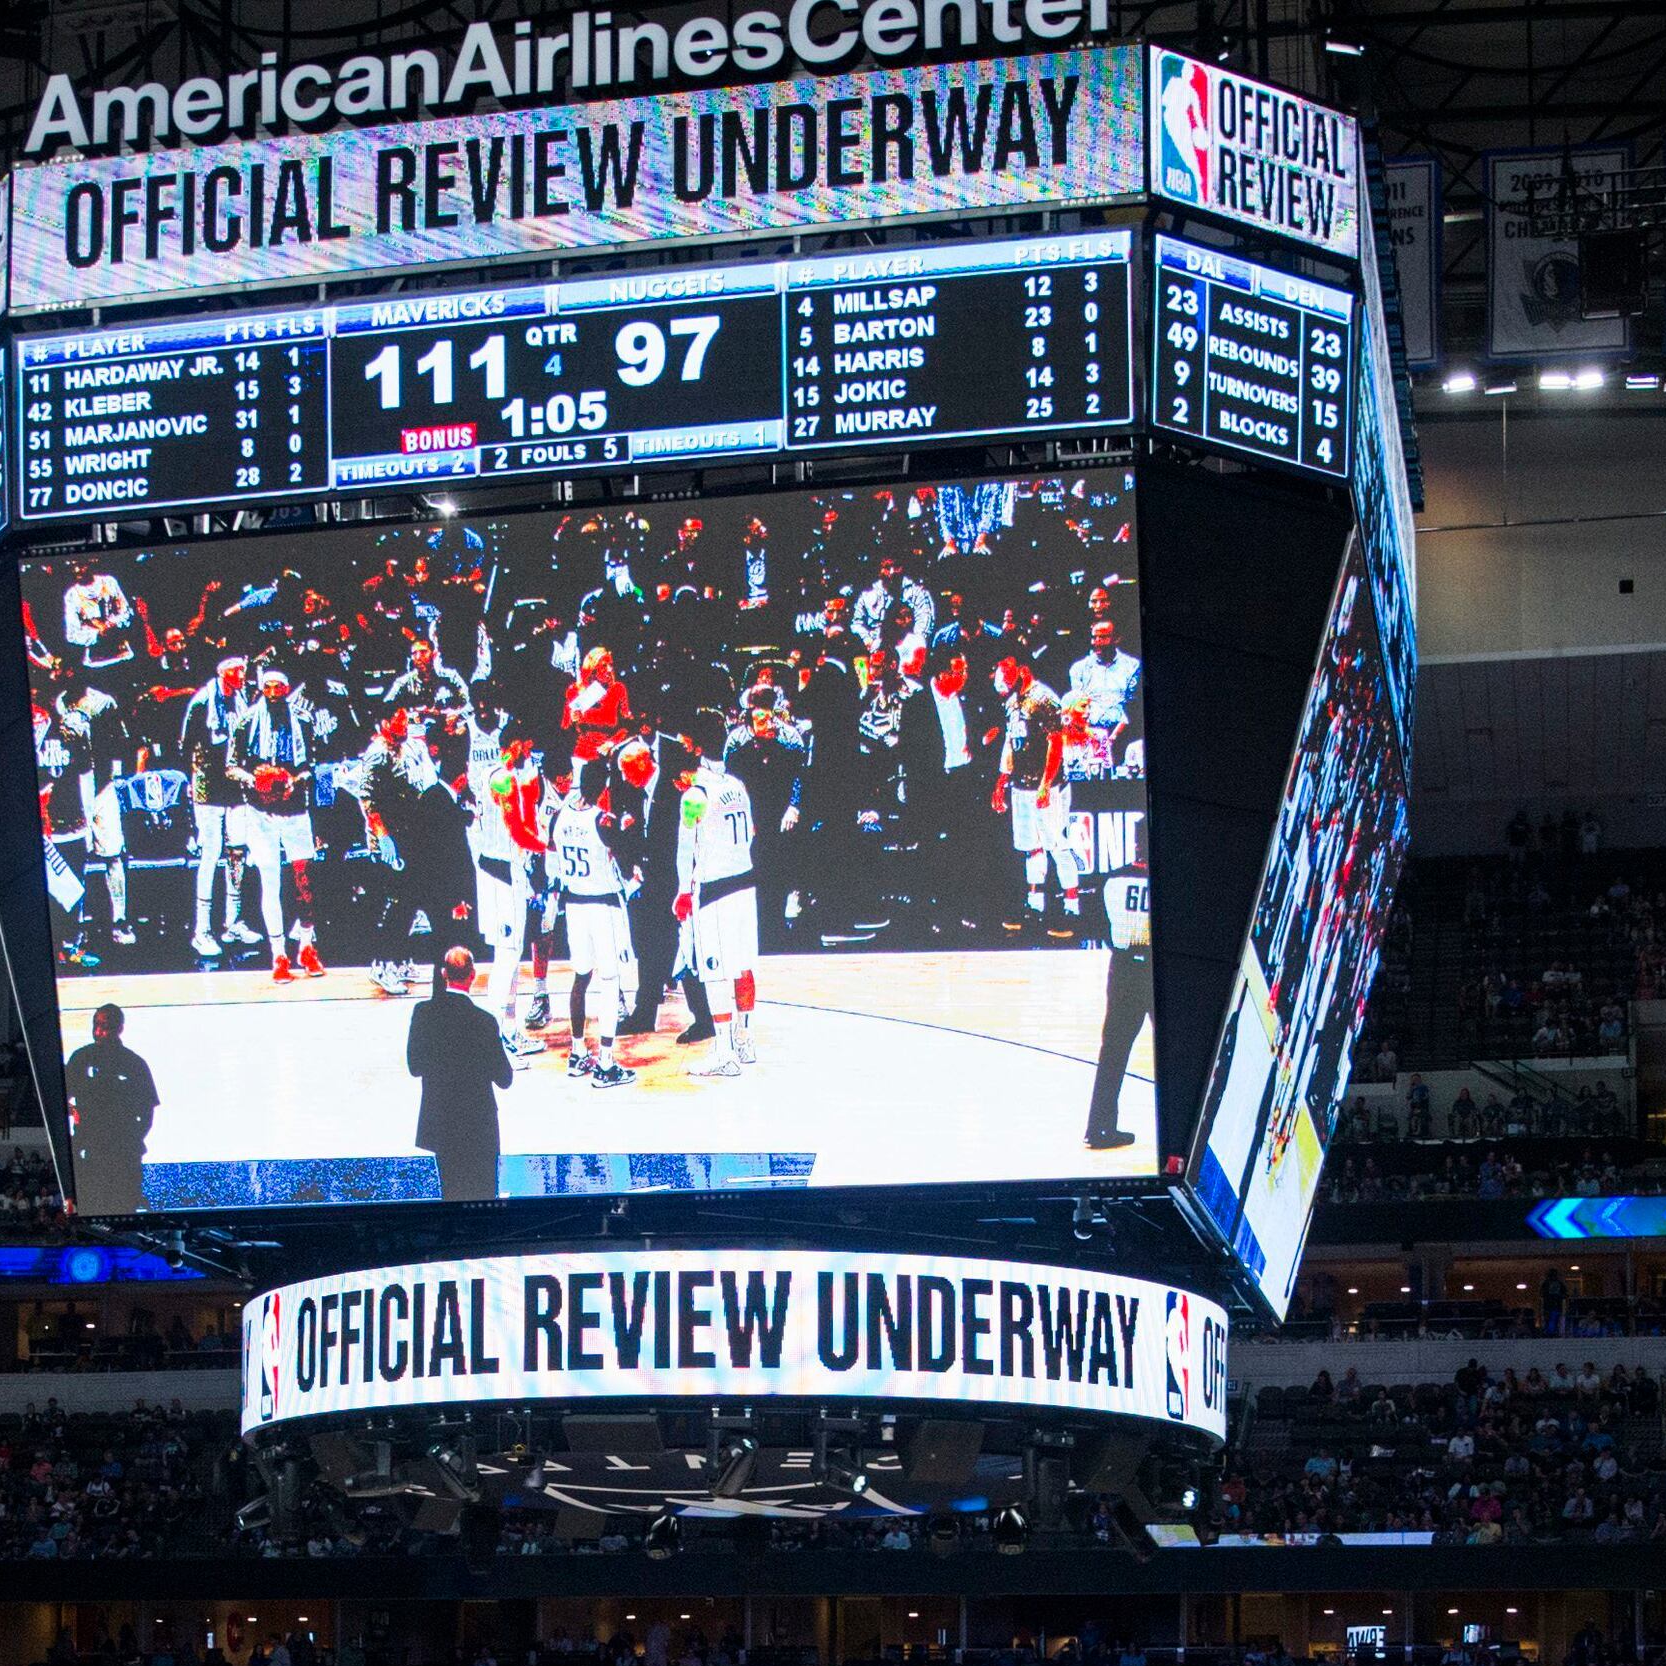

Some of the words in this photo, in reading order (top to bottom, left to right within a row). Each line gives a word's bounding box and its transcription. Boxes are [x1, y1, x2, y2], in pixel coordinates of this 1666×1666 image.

[1219, 78, 1346, 178] OFFICIAL
[65, 155, 351, 269] OFFICIAL
[376, 119, 645, 235] REVIEW
[672, 76, 1081, 203] UNDERWAY
[1218, 144, 1335, 240] REVIEW
[834, 255, 924, 282] PLAYER
[1014, 244, 1061, 265] PTS
[1069, 239, 1113, 261] FLS
[1187, 249, 1226, 283] DAL
[1284, 279, 1325, 312] DEN
[371, 293, 506, 327] MAVERICKS
[609, 272, 726, 303] NUGGETS
[797, 296, 814, 317] 4
[833, 286, 936, 315] MILLSAP
[1024, 276, 1052, 297] 12
[1084, 272, 1098, 292] 3
[64, 334, 146, 359] PLAYER
[225, 320, 267, 342] PTS
[275, 314, 316, 337] FLS
[524, 322, 578, 347] QTR
[799, 326, 813, 347] 5
[834, 316, 935, 344] BARTON
[1024, 306, 1052, 328] 23
[1084, 302, 1098, 323] 0
[1166, 286, 1200, 316] 23
[1219, 302, 1290, 340] ASSISTS
[1310, 329, 1342, 358] 23
[28, 372, 50, 394] 11
[64, 359, 184, 390] HARDAWAY
[189, 356, 224, 377] JR.
[234, 351, 261, 372] 14
[288, 347, 300, 367] 1
[363, 334, 508, 410] 111
[614, 314, 722, 387] 97
[544, 353, 562, 377] 4
[793, 357, 820, 378] 14
[834, 347, 925, 375] HARRIS
[1032, 336, 1046, 358] 8
[1085, 332, 1098, 354] 1
[1166, 322, 1199, 352] 49
[1208, 335, 1300, 379] REBOUNDS
[1310, 364, 1342, 395] 39
[27, 401, 52, 423] 42
[64, 392, 152, 419] KLEBER
[234, 380, 260, 401] 15
[288, 376, 302, 395] 3
[793, 386, 820, 408] 15
[834, 379, 907, 404] JOKIC
[1026, 366, 1054, 388] 14
[1085, 362, 1100, 384] 3
[1173, 361, 1190, 387] 9
[1208, 371, 1299, 415] TURNOVERS
[1313, 400, 1338, 429] 15
[29, 430, 51, 451] 51
[64, 414, 208, 447] MARJANOVIC
[235, 409, 258, 429] 31
[288, 404, 301, 424] 1
[500, 390, 608, 438] 1:05
[794, 416, 820, 438] 27
[835, 406, 936, 434] MURRAY
[1026, 397, 1053, 419] 25
[1085, 394, 1100, 414] 2
[1172, 398, 1189, 424] 2
[1220, 410, 1290, 446] BLOCKS
[1315, 438, 1334, 464] 4
[29, 458, 53, 478] 55
[64, 448, 152, 476] WRIGHT
[241, 438, 254, 458] 8
[288, 433, 302, 453] 0
[404, 426, 474, 453] BONUS
[494, 447, 509, 470] 2
[521, 443, 587, 465] FOULS
[603, 437, 618, 460] 5
[636, 429, 741, 455] TIMEOUTS
[753, 425, 767, 447] 1
[29, 487, 53, 508] 77
[65, 477, 148, 505] DONCIC
[235, 466, 261, 487] 28
[289, 462, 303, 483] 2
[339, 456, 441, 482] TIMEOUTS
[452, 452, 466, 474] 2
[723, 811, 750, 845] 77
[562, 846, 590, 878] 55
[296, 1277, 500, 1394] OFFICIAL
[523, 1269, 792, 1373] REVIEW
[817, 1271, 1139, 1390] UNDERWAY
